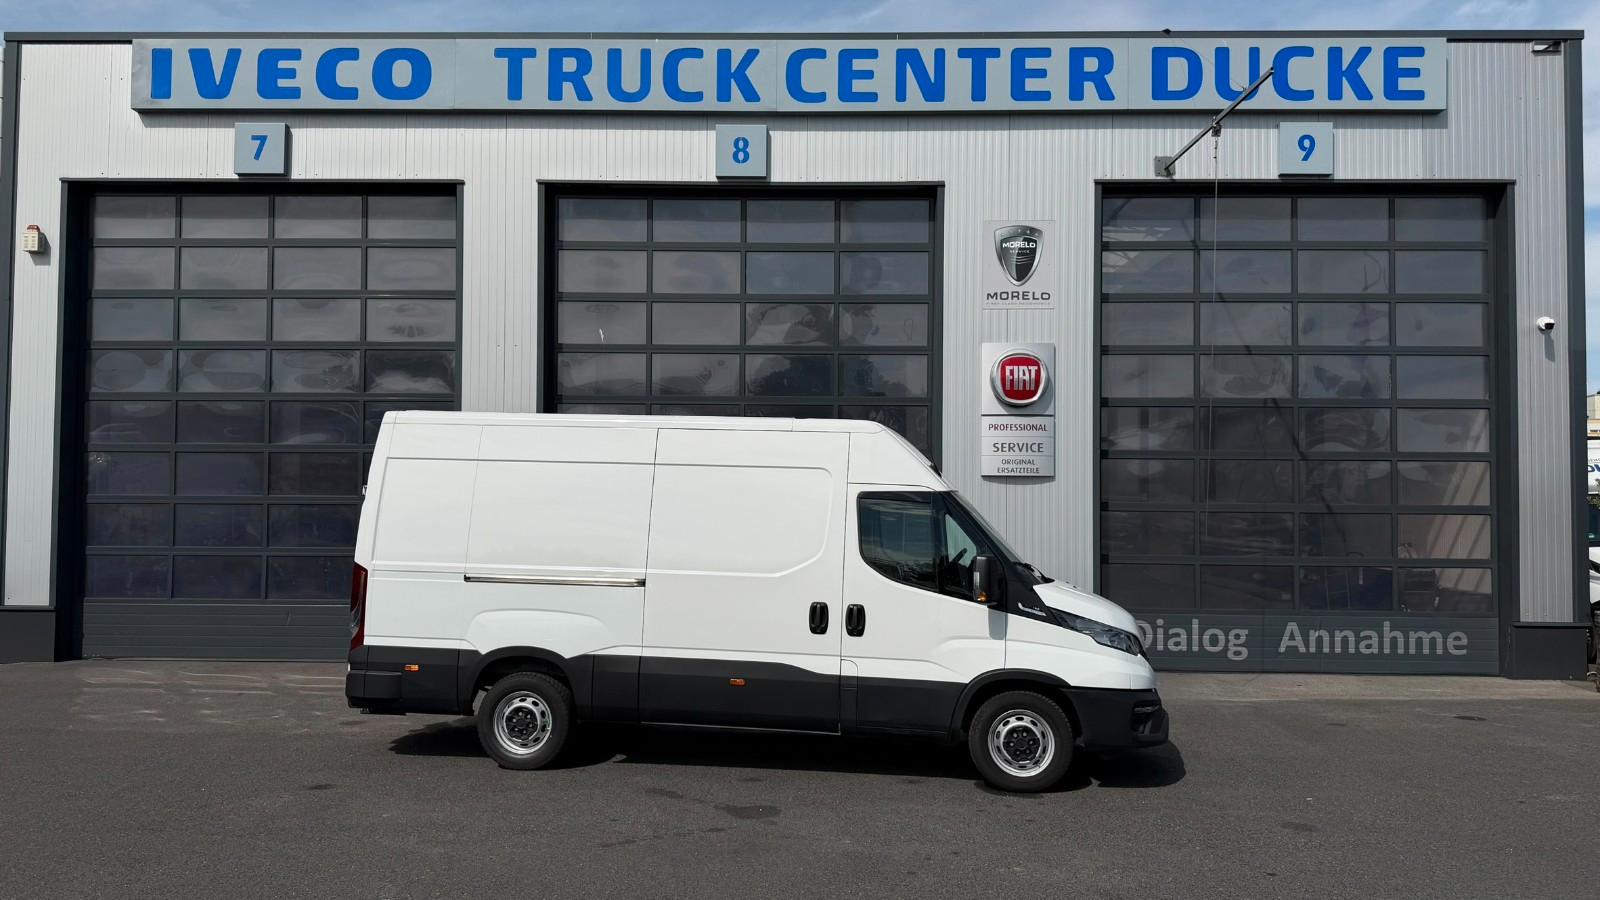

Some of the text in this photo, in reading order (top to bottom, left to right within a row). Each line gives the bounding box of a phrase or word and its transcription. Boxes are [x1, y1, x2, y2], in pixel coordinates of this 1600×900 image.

[151, 46, 1426, 104] IVECO TRUCK CENTER DUCKE
[250, 134, 269, 161] 7
[732, 136, 751, 164] 8
[1297, 134, 1317, 162] 9
[986, 291, 1051, 301] MORELO
[1004, 365, 1039, 391] FIAT
[988, 423, 1048, 432] PROFESSIONAL
[992, 442, 1045, 453] SERVICE
[1001, 458, 1036, 466] ORIGINAL
[1277, 620, 1469, 656] Annahme
